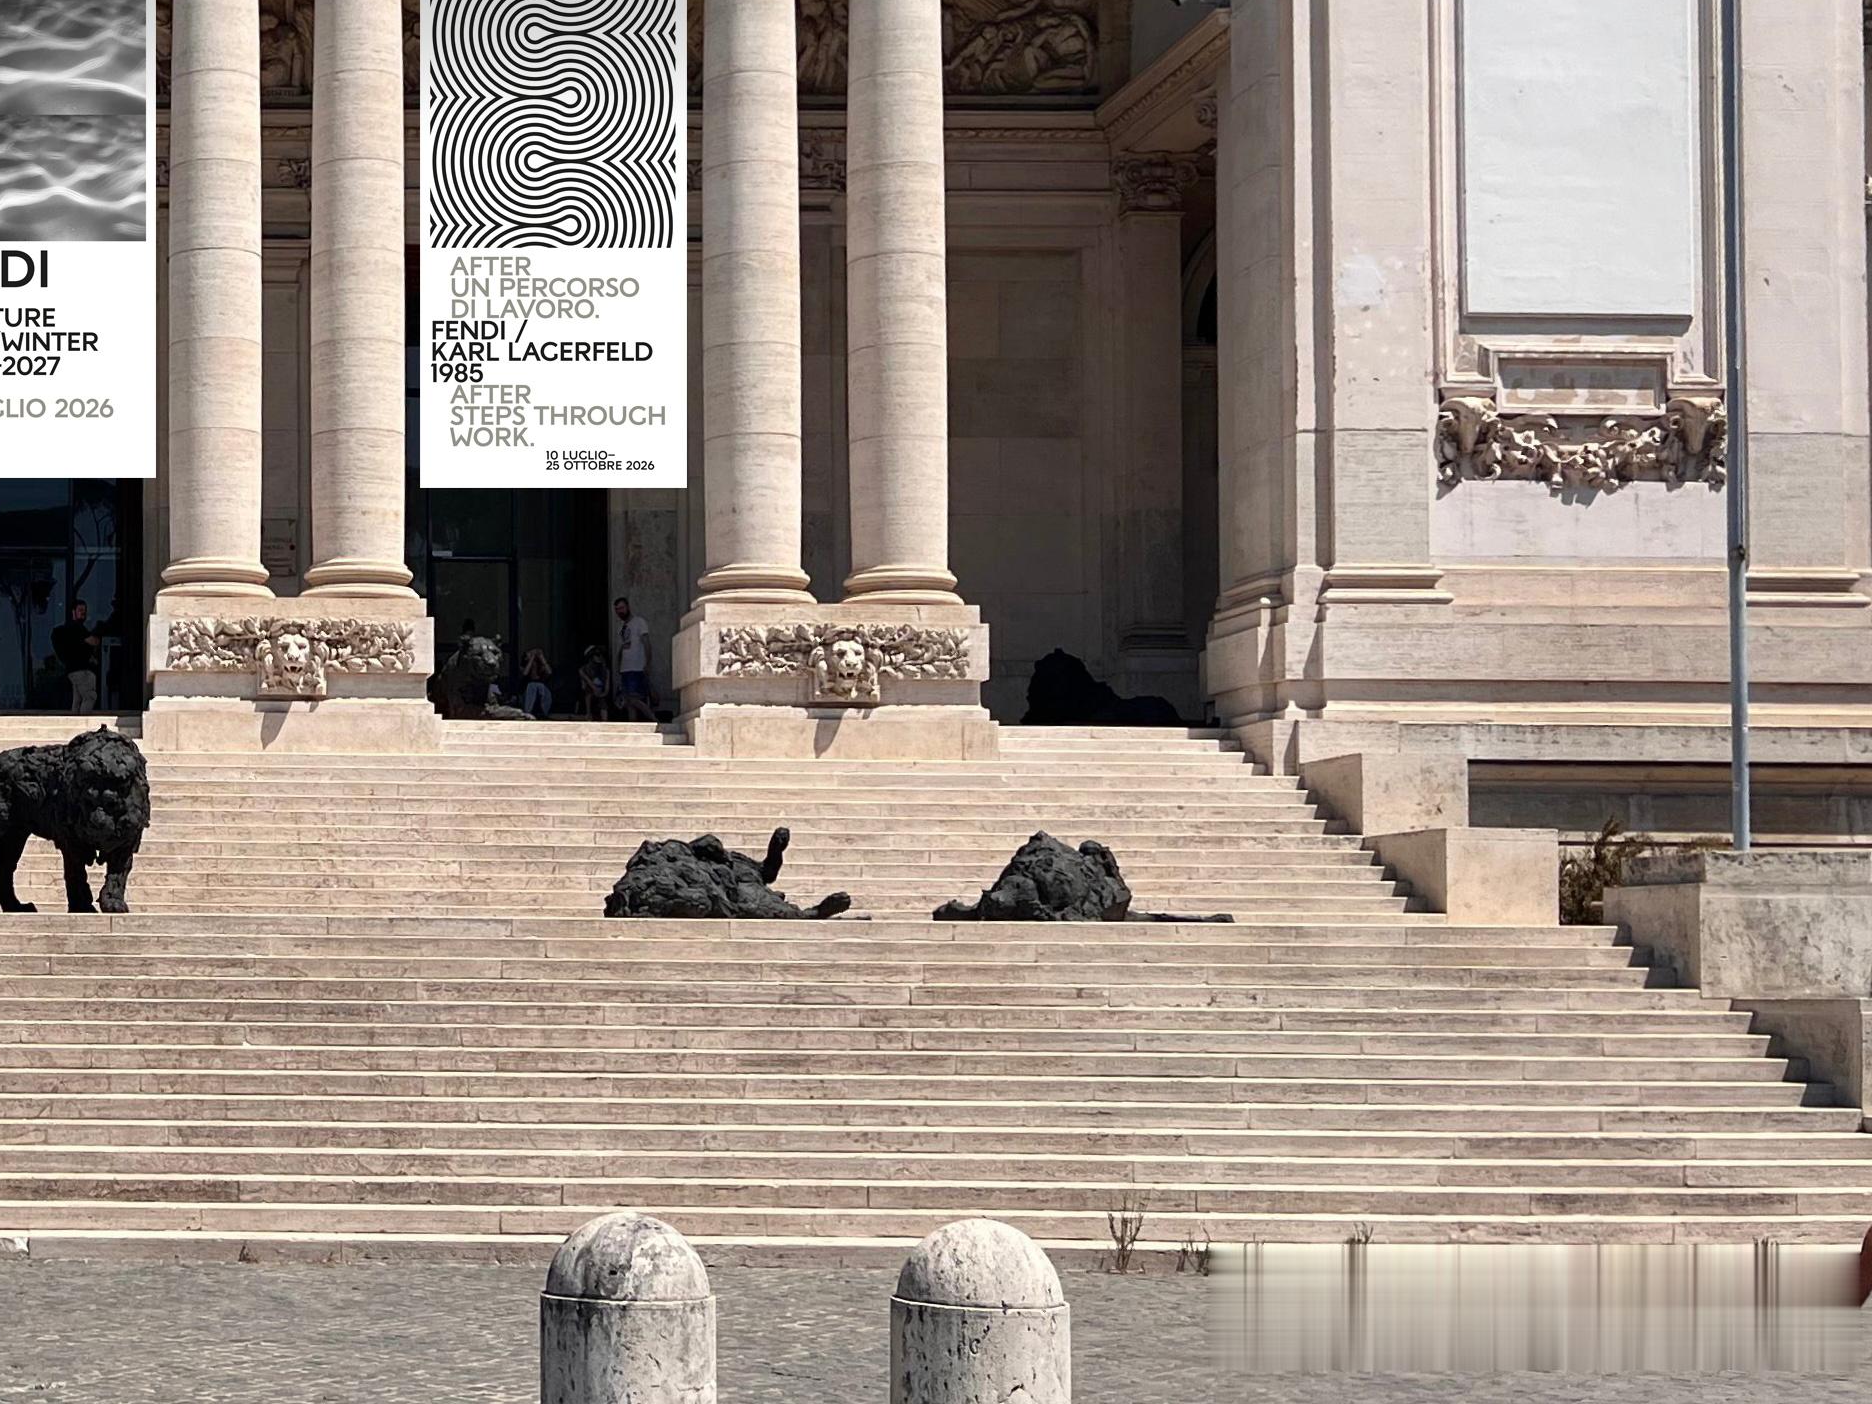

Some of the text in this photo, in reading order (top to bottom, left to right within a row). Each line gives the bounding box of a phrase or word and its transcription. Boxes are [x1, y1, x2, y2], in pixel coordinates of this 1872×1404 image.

[450, 256, 531, 276] AFTER
[452, 278, 639, 297] UN PERCORSO
[452, 299, 599, 319] DI LAVORO.
[432, 320, 528, 343] FENDI /
[432, 341, 653, 361] KARL LAGERFELD
[431, 363, 483, 383] 1985
[450, 385, 531, 404] AFTER
[55, 398, 113, 418] 2026
[450, 406, 665, 425] STEPS THROUGH
[450, 427, 534, 447] WORK.
[546, 450, 558, 460] 10
[546, 461, 655, 470] 25 OTTOBRE 2026
